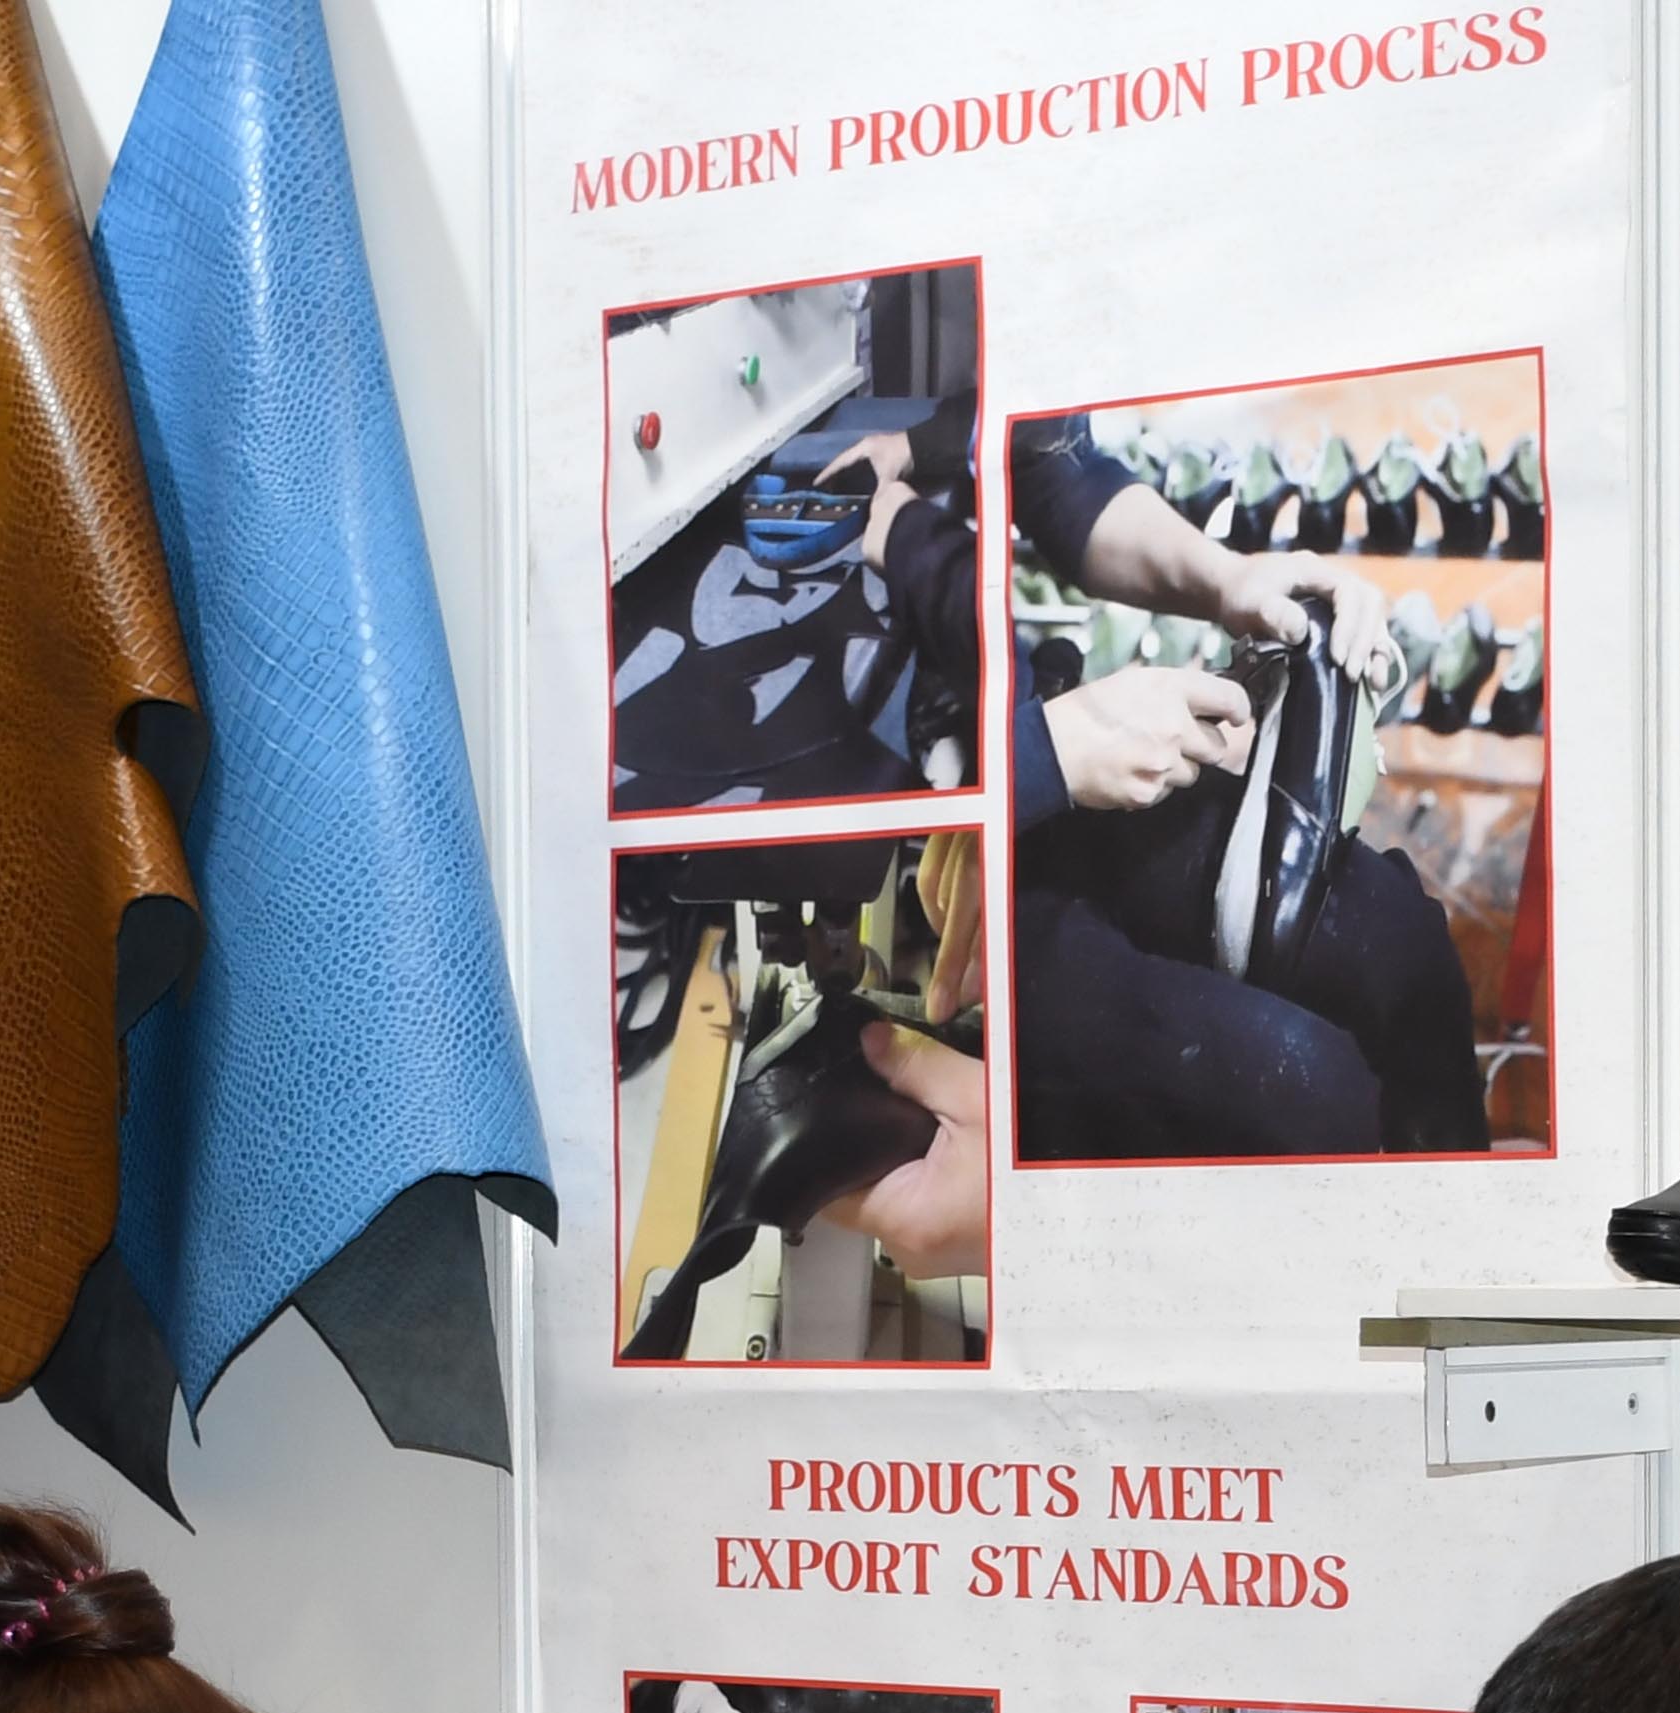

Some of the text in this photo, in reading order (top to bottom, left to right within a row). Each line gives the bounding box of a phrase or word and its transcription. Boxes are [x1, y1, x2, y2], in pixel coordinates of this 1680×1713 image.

[571, 5, 1547, 215] MODERN PRODUCTION PROCESS
[767, 1458, 1284, 1524] PRODUCTS MEET
[714, 1536, 1349, 1611] EXPORT STANDARDS
